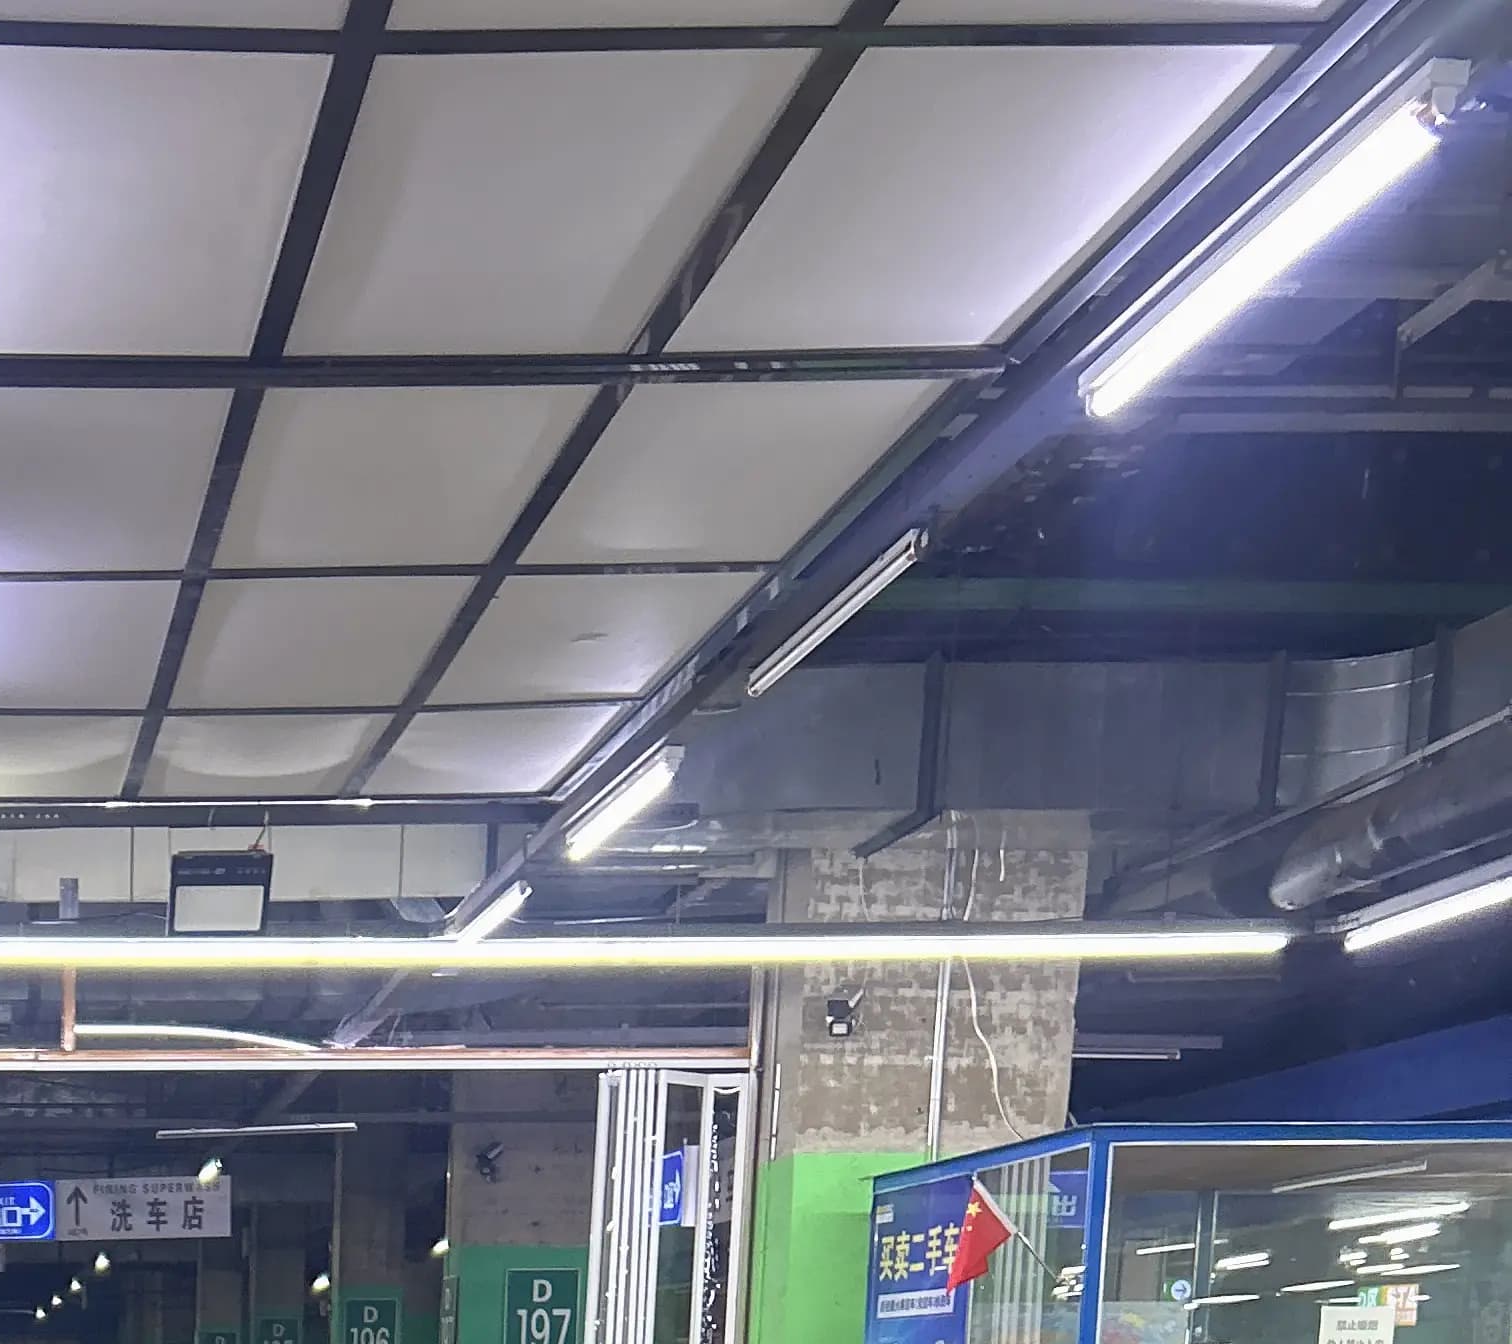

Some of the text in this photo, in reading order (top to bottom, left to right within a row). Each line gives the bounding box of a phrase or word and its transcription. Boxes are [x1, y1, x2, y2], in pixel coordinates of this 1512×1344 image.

[110, 1196, 204, 1232] 洗车店
[879, 1222, 960, 1282] 买卖二手车
[532, 1279, 553, 1303] D
[363, 1306, 378, 1323] D
[272, 1323, 285, 1337] D
